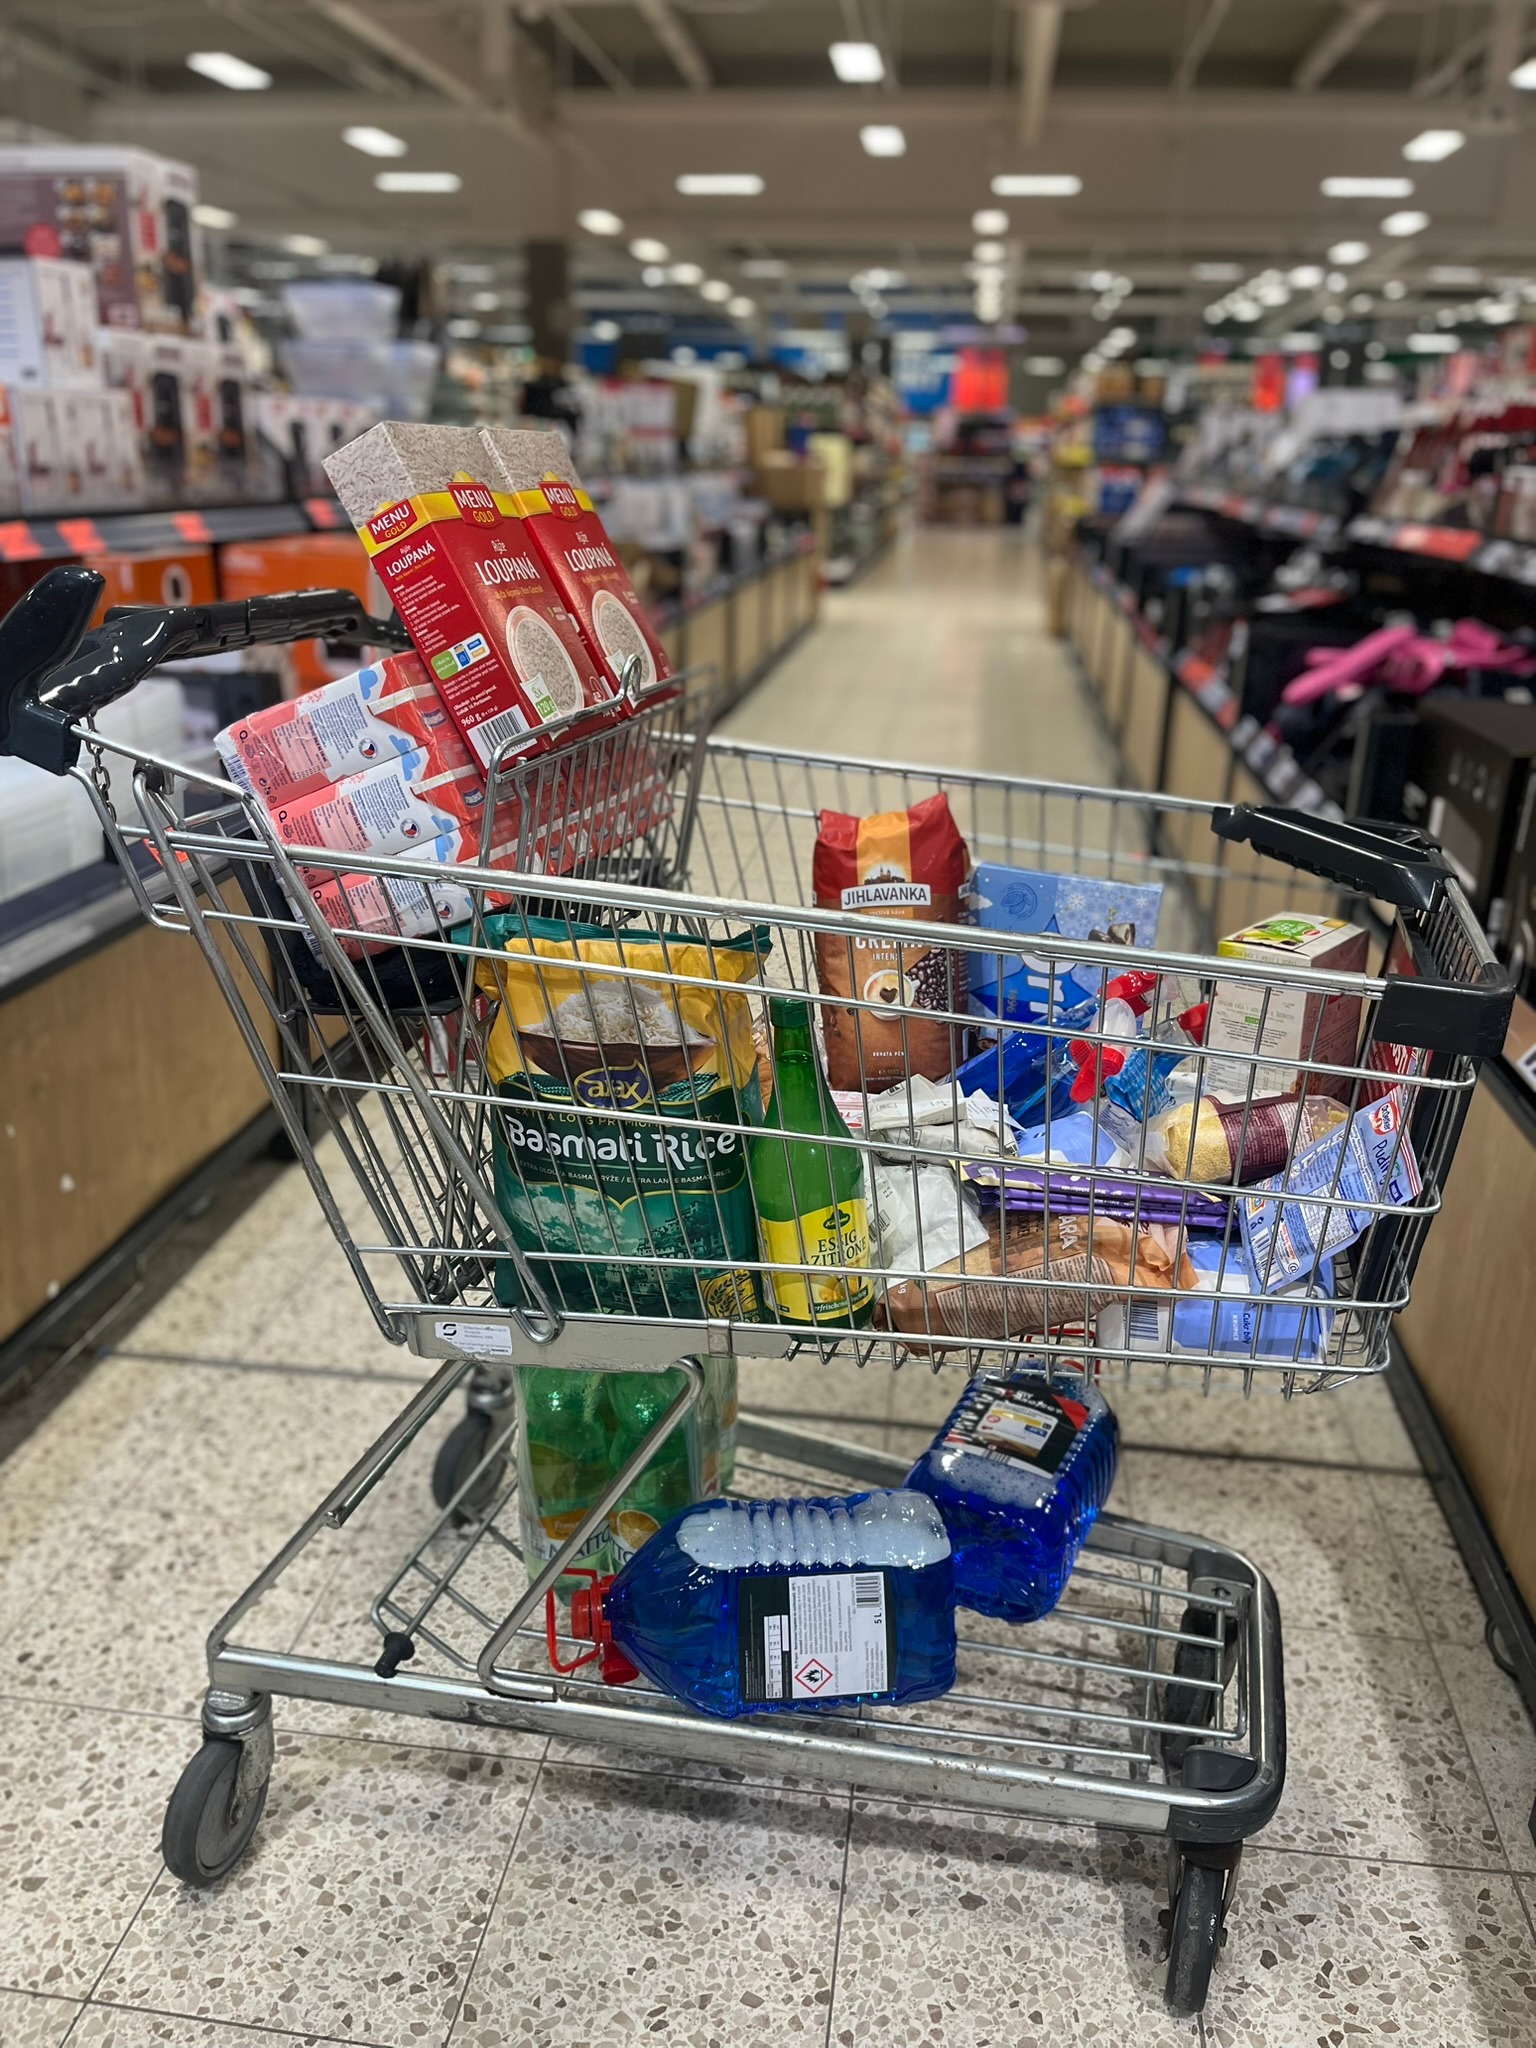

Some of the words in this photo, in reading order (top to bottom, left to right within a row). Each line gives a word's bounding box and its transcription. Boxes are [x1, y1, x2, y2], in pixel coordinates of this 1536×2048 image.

[452, 489, 495, 509] MENU
[543, 487, 577, 505] MENU
[370, 504, 411, 536] MENU
[472, 510, 495, 523] GOLD
[559, 505, 579, 517] GOLD
[384, 520, 408, 539] GOLD
[385, 540, 437, 578] LOUPANÁ
[564, 541, 617, 573] LOUPANÁ
[474, 551, 541, 586] LOUPANÁ
[461, 714, 475, 726] 960
[475, 712, 482, 723] g
[844, 886, 928, 906] JIHLAVANKA
[559, 1113, 594, 1125] LOG
[505, 1114, 648, 1164] Basmati
[651, 1131, 736, 1171] Rice
[626, 1176, 652, 1184] ETRA
[653, 1177, 680, 1185] LANE
[1242, 1312, 1251, 1331] Cukr
